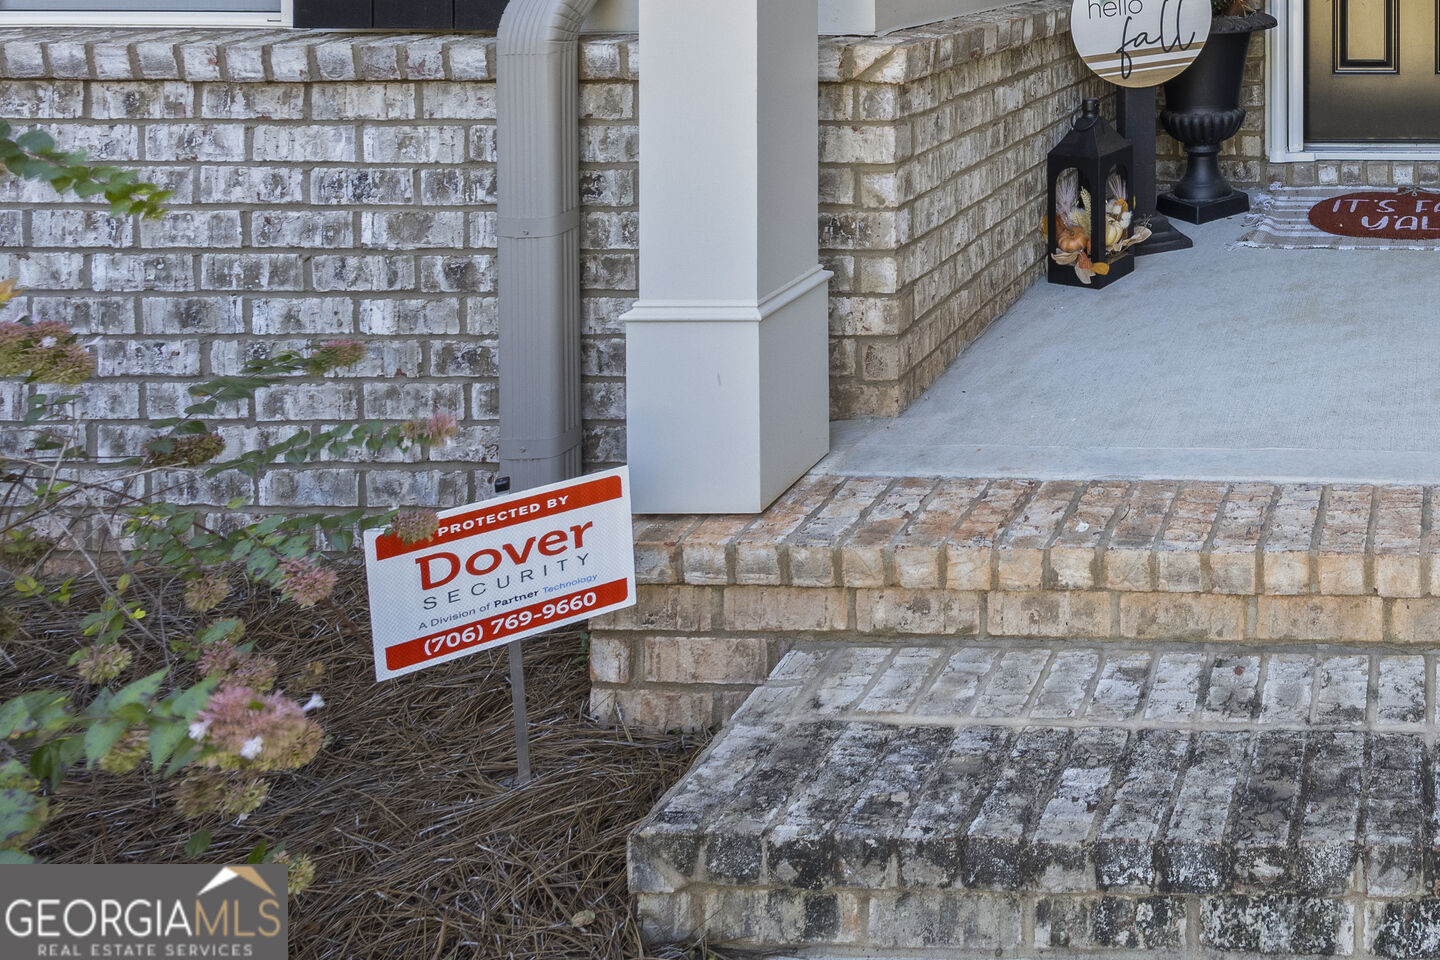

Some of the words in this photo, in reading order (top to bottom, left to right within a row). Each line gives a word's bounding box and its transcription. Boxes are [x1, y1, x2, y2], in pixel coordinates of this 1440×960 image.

[1332, 199, 1398, 213] IT'S
[438, 502, 541, 537] PROTECTED
[547, 495, 569, 509] BY
[415, 520, 593, 591] Dover
[423, 552, 590, 610] SECURITY
[418, 622, 428, 631] A
[430, 608, 476, 628] Division
[479, 602, 491, 613] of
[494, 589, 539, 608] Partner
[542, 573, 598, 595] Technology
[424, 623, 484, 656] (706)
[490, 592, 597, 635] 769-9660
